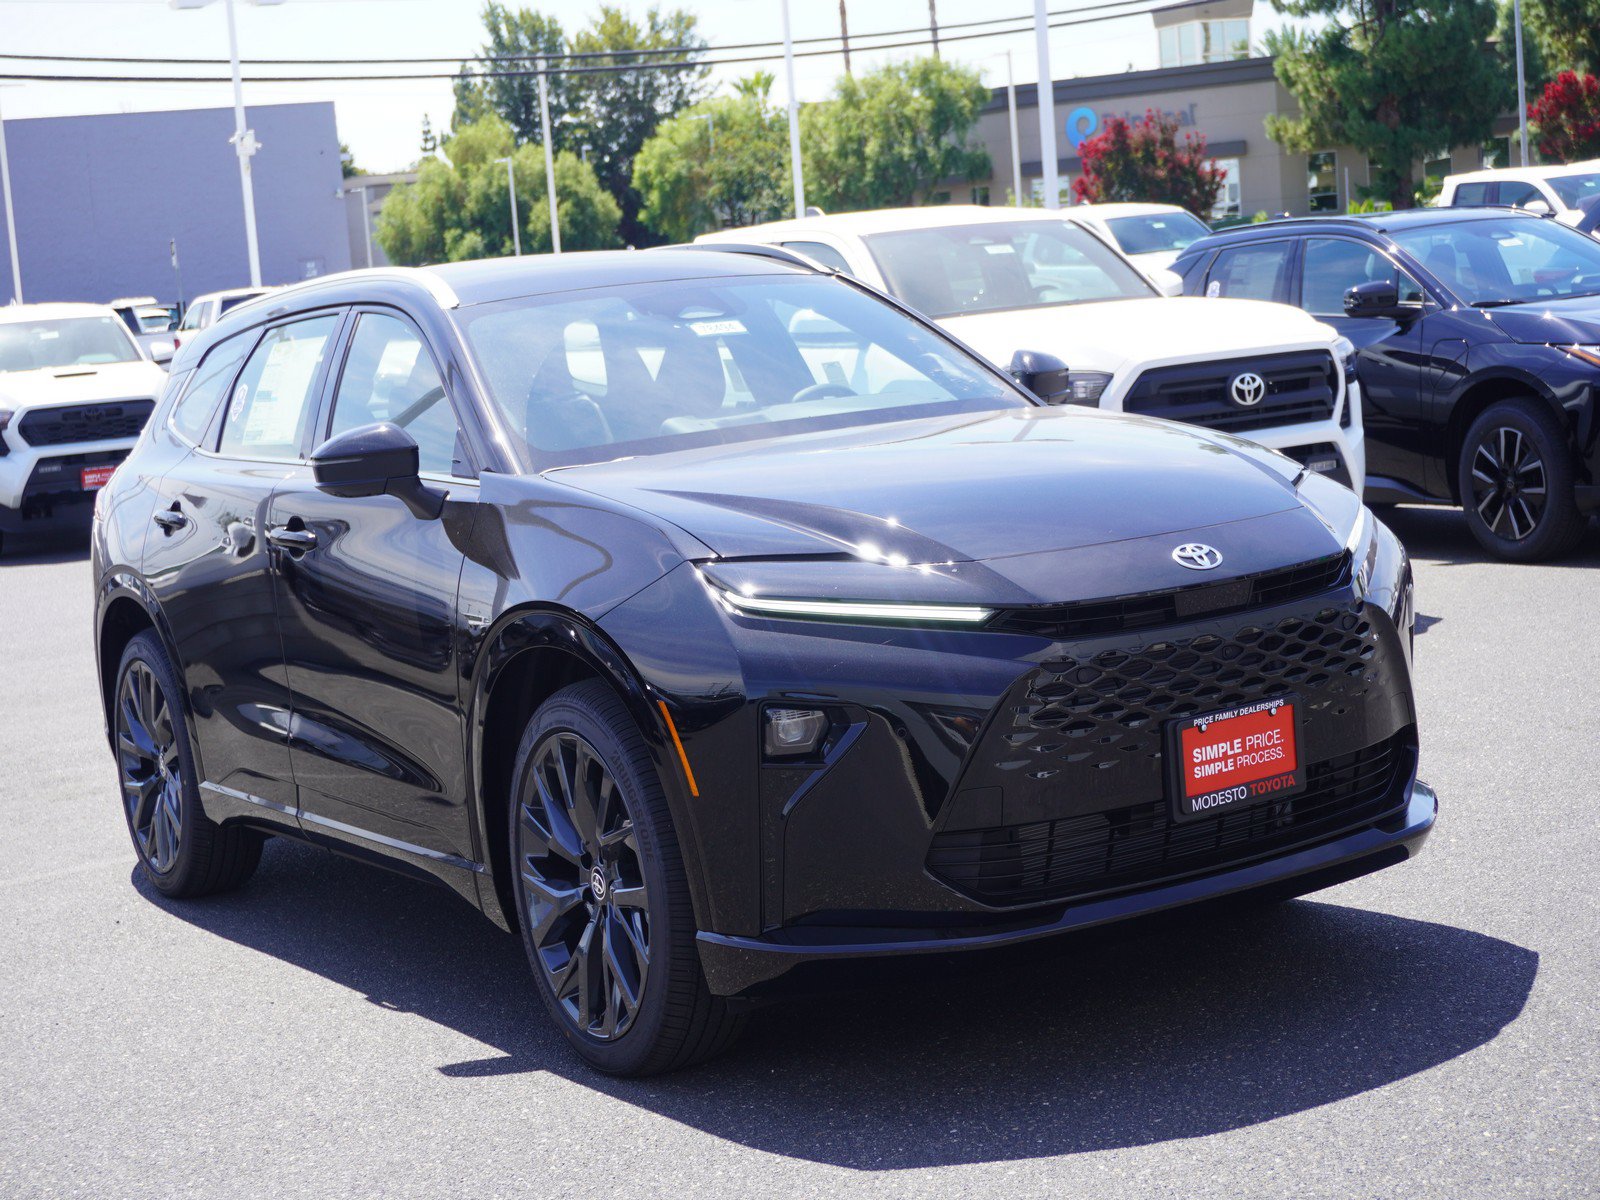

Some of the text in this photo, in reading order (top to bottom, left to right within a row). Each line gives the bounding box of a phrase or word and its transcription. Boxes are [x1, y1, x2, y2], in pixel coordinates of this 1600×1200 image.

[1193, 699, 1284, 726] PRICE FAMILY DEALERSHIPS
[1192, 728, 1284, 764] SIMPLE PRICE.
[1193, 746, 1285, 779] SIMPLE PROCESS.
[610, 753, 656, 864] BRIDGESTONE
[1192, 775, 1296, 812] MODESTO TOYOTA
